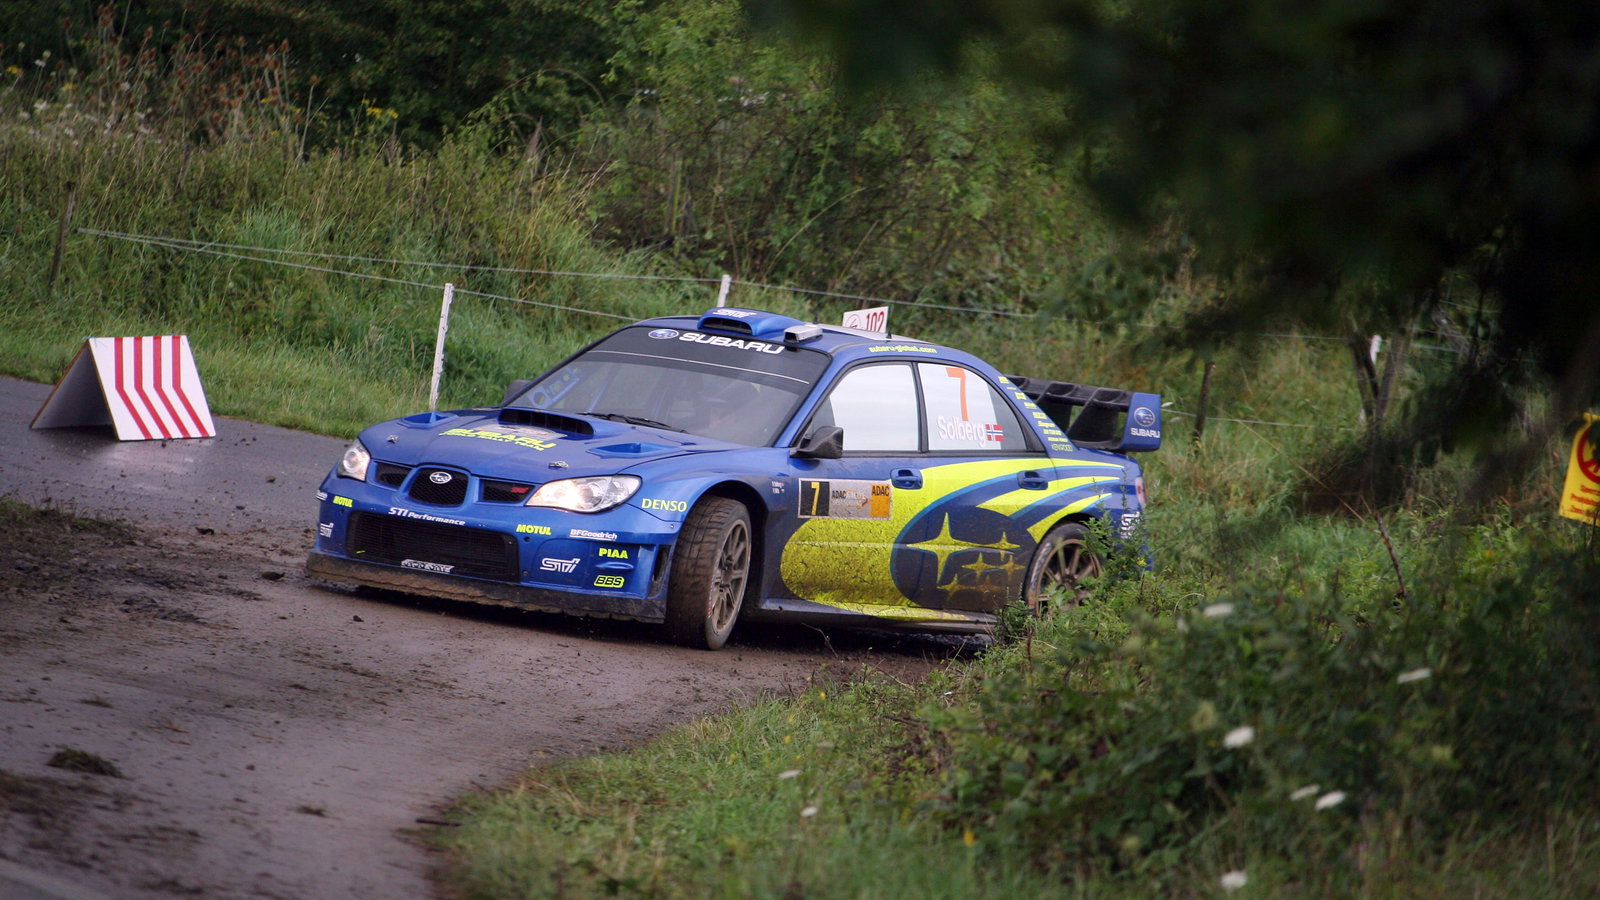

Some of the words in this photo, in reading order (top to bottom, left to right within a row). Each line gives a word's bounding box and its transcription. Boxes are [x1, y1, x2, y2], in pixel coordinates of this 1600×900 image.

[865, 310, 885, 332] 102
[679, 332, 785, 355] SUBARU
[946, 367, 969, 421] 7
[937, 415, 986, 448] Solberg
[1130, 427, 1160, 438] SUBARU
[831, 490, 847, 499] ADAC
[871, 484, 890, 497] ADAC
[641, 498, 688, 512] DENSO
[810, 481, 820, 516] 7
[388, 507, 408, 517] STI
[408, 511, 465, 526] Performance
[516, 523, 552, 536] MOTUL
[570, 528, 618, 540] BFGoodrich
[598, 547, 628, 559] PIAA
[594, 575, 625, 588] BBS
